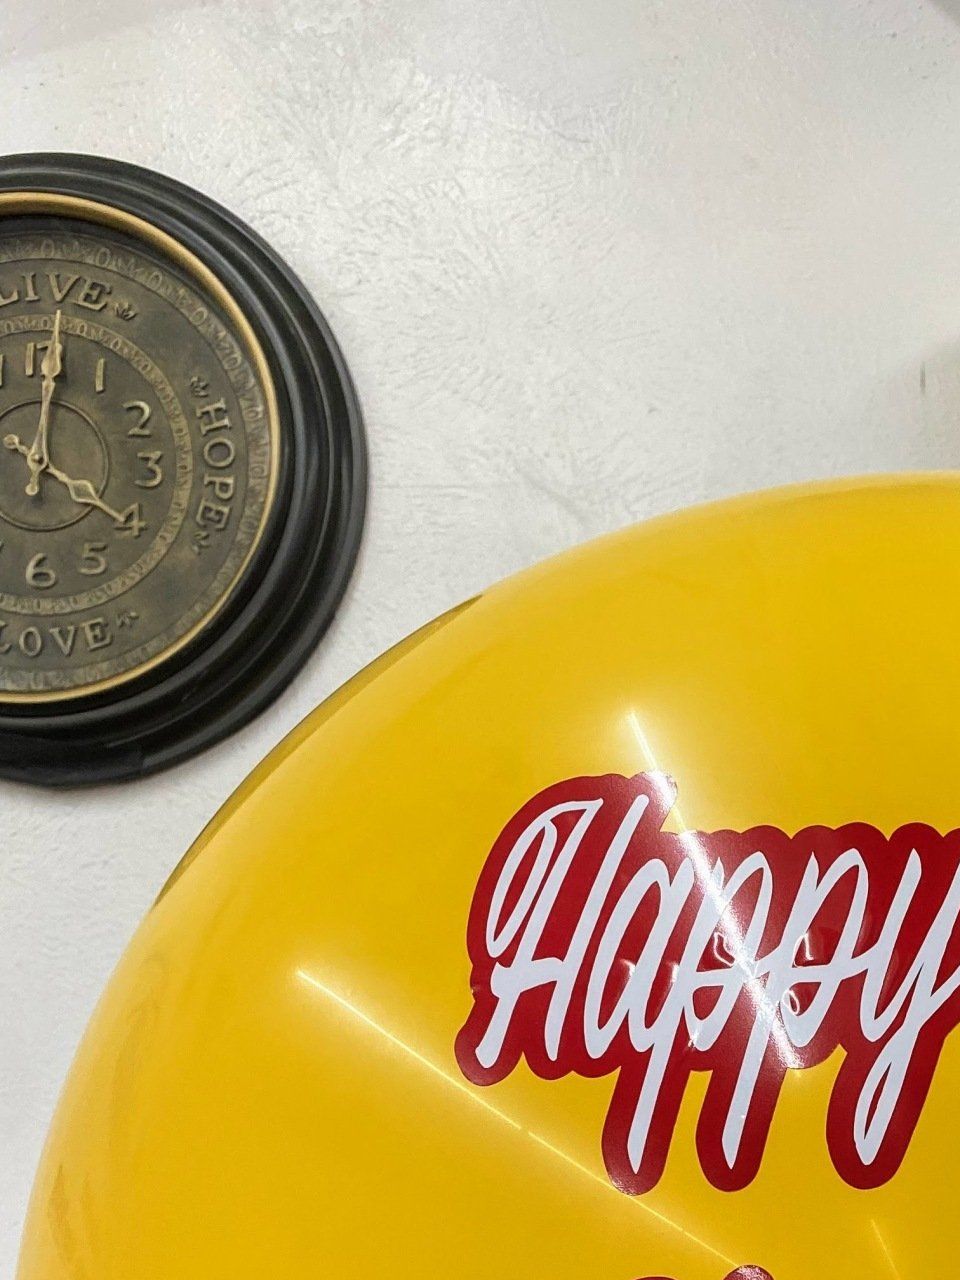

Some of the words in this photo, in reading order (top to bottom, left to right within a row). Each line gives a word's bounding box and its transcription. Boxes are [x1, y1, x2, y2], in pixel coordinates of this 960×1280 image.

[95, 358, 105, 393] 1
[123, 401, 151, 437] 2
[135, 451, 163, 488] 3
[195, 400, 236, 530] HOPE
[113, 503, 147, 538] 4
[25, 552, 56, 589] 6
[79, 542, 108, 576] 5
